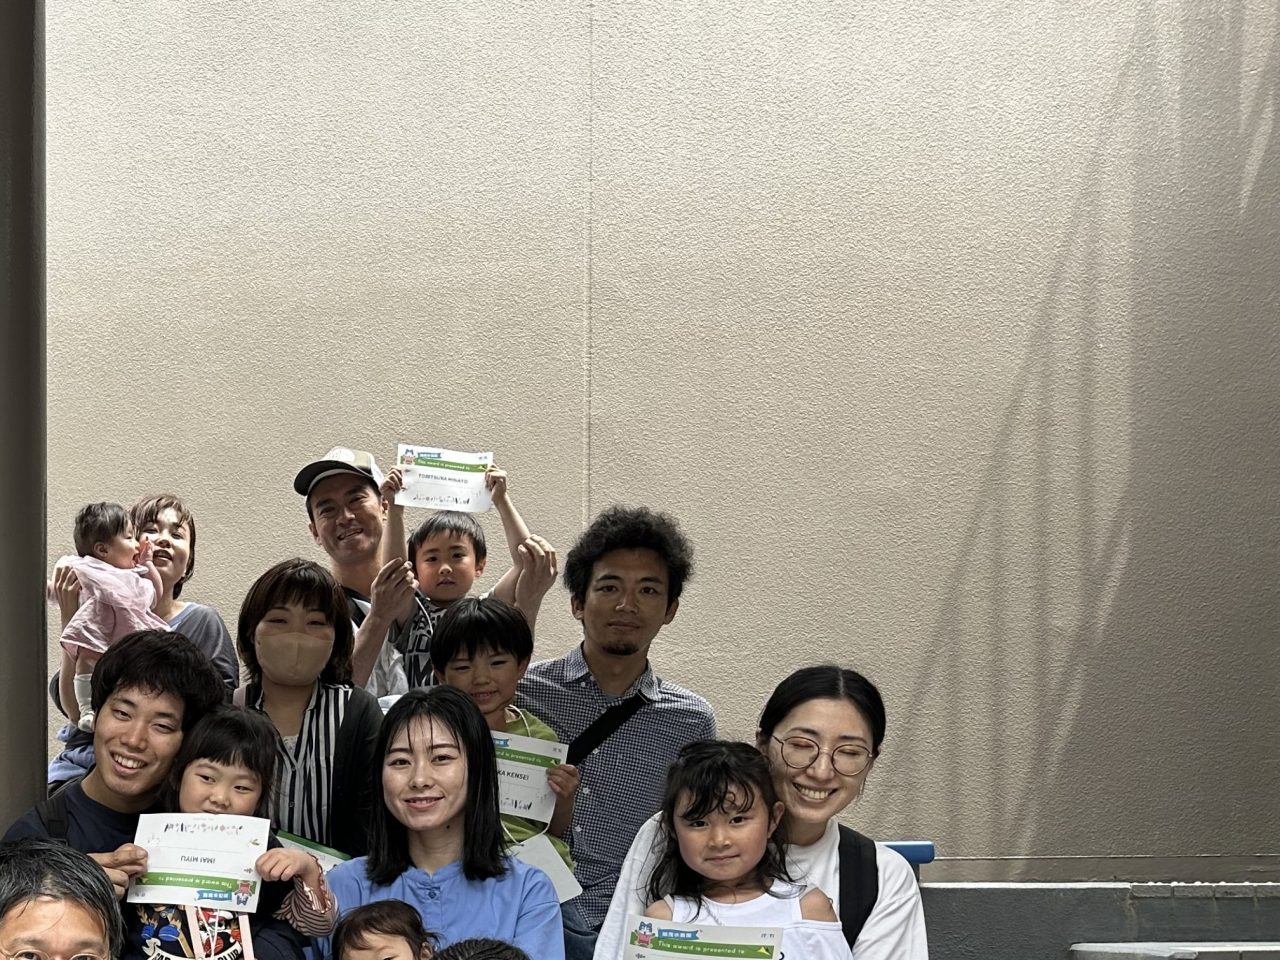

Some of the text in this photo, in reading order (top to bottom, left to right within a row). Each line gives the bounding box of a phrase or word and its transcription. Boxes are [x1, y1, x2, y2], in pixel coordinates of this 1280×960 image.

[506, 770, 530, 780] KENSEI
[672, 942, 694, 950] award
[703, 946, 736, 954] presented
